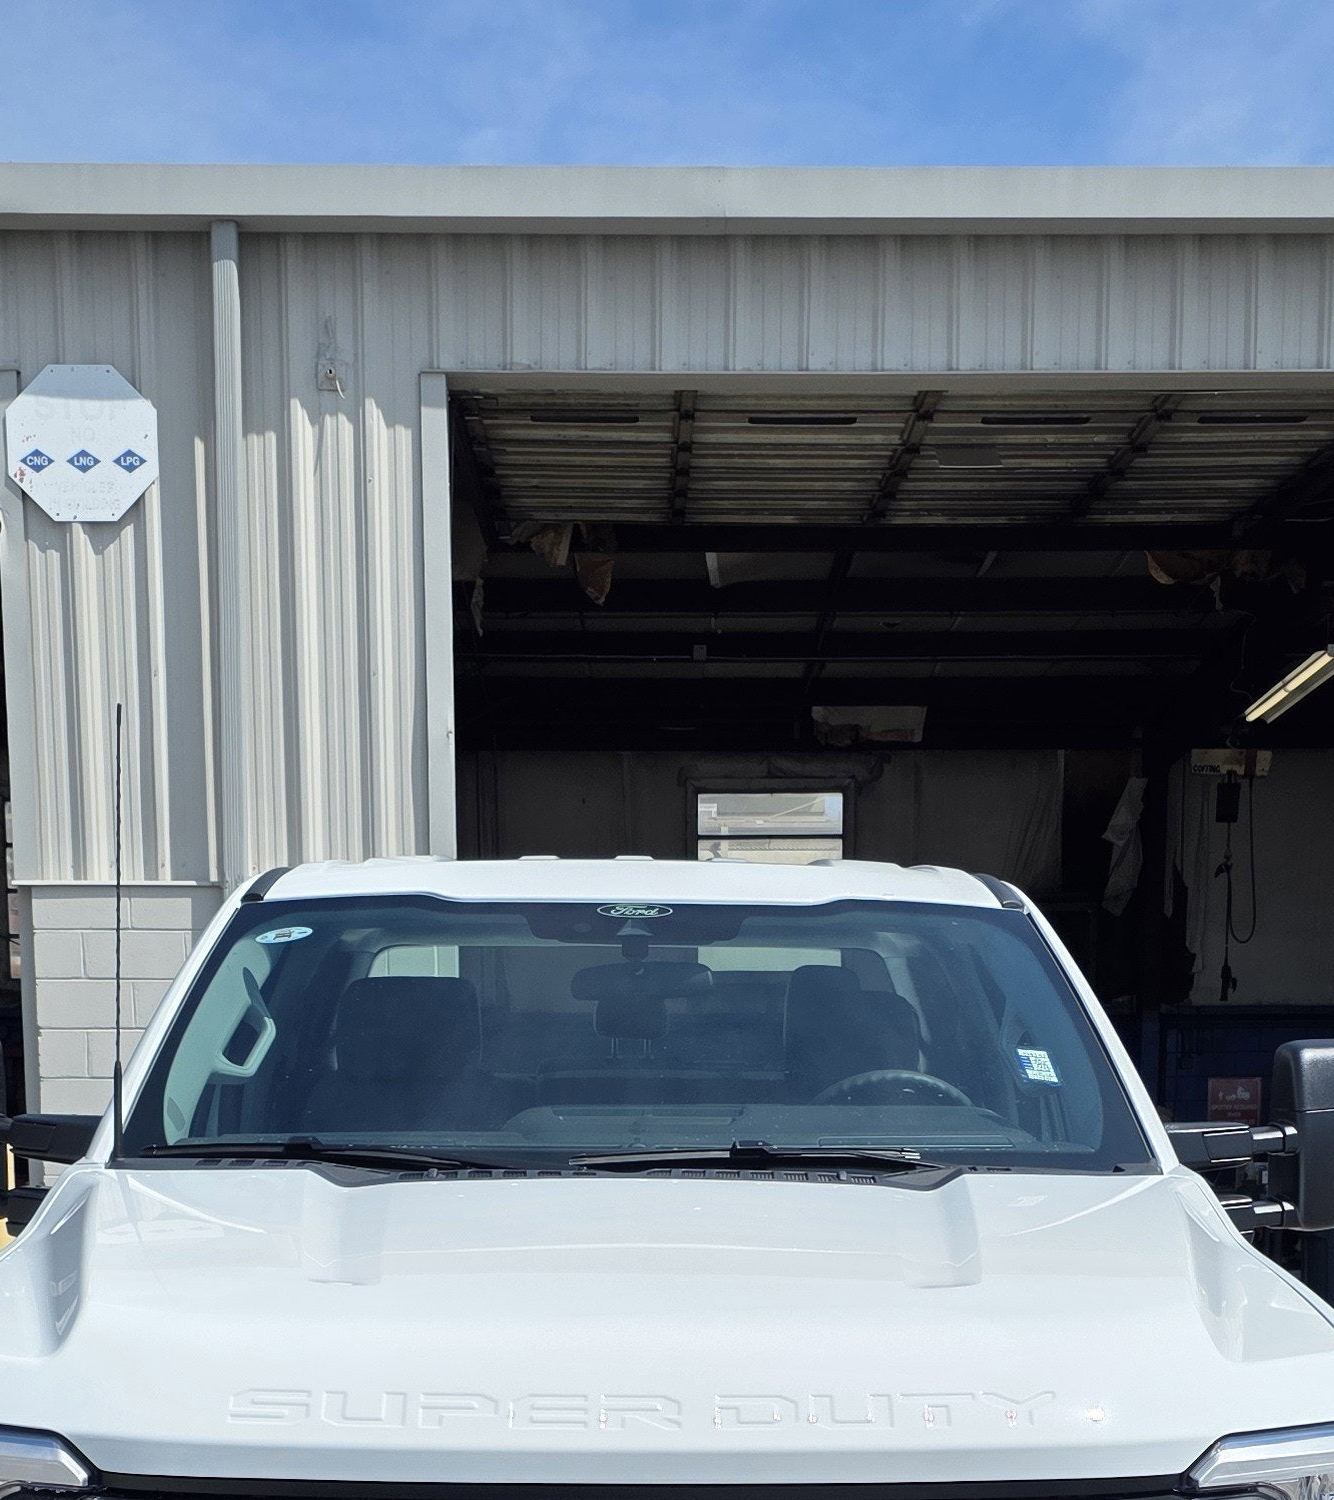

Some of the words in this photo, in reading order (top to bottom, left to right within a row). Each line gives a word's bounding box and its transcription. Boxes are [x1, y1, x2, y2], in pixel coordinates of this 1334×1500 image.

[26, 456, 49, 466] CNG
[73, 456, 94, 466] LNG
[120, 456, 140, 466] LPG
[610, 905, 660, 916] Ford
[227, 1387, 683, 1431] SUPER
[714, 1390, 1056, 1431] DUTY
